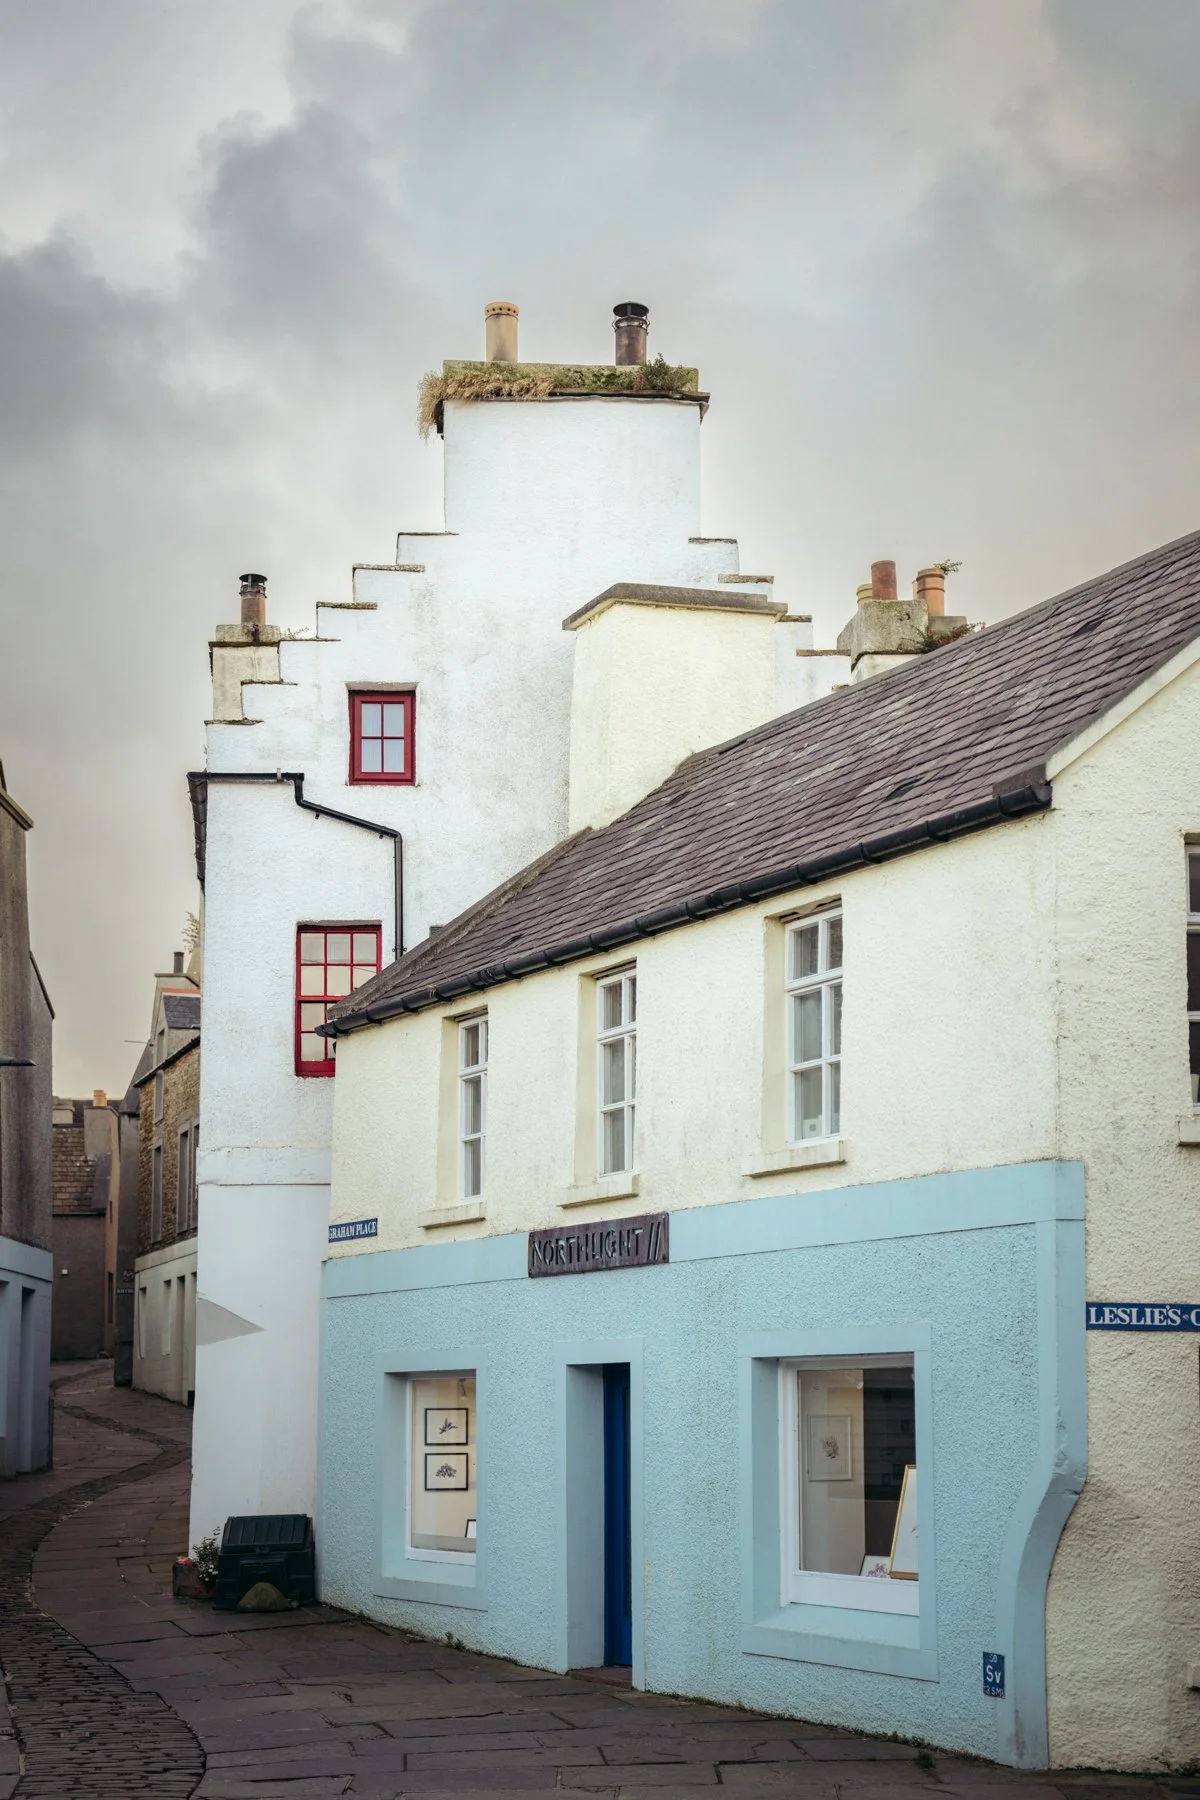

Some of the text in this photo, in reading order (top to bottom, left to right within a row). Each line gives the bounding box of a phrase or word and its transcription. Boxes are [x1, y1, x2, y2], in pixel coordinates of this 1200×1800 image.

[328, 1221, 377, 1240] GRAHAM PLACE
[532, 1227, 644, 1267] NORTHLIGHT
[1089, 1305, 1181, 1326] LESLIE'S
